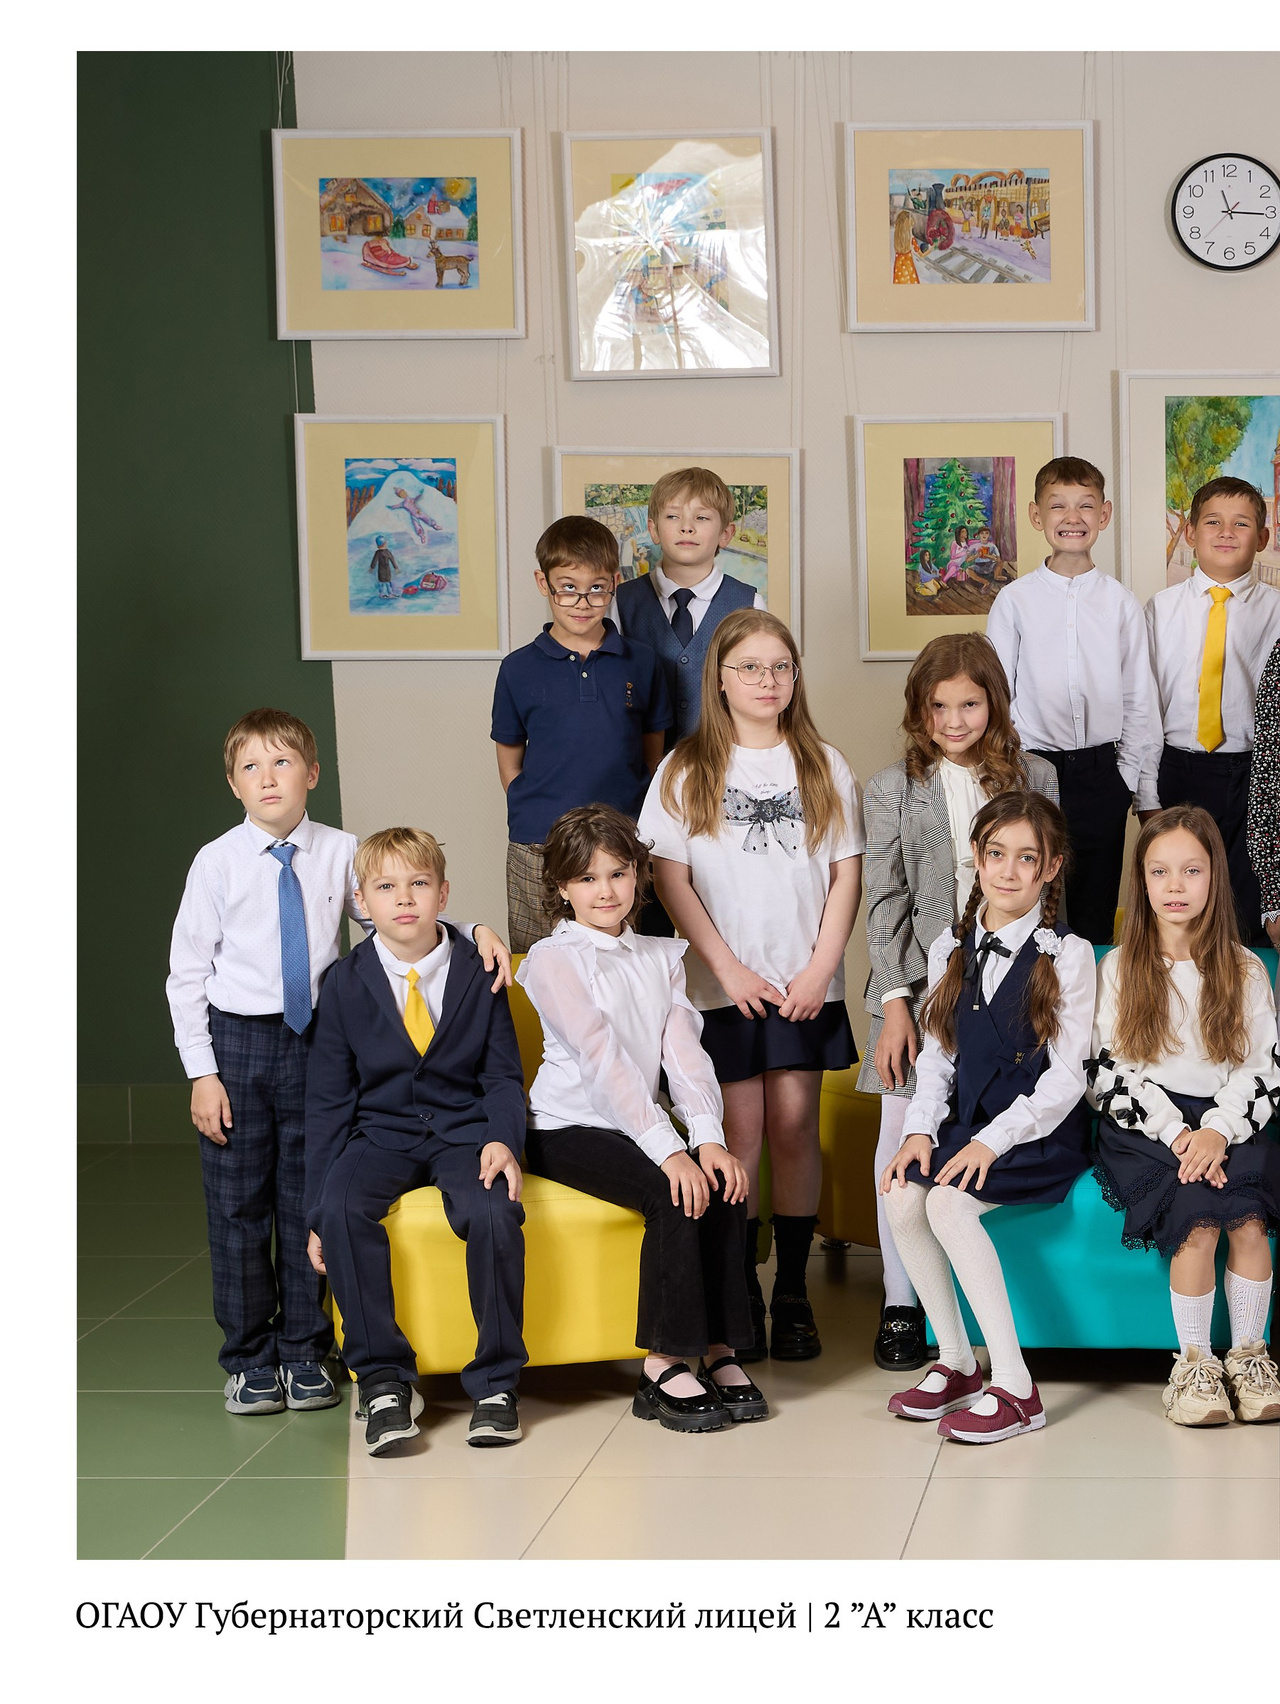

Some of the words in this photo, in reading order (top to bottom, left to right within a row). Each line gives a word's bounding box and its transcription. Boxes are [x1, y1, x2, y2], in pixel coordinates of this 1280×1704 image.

[1203, 169, 1214, 183] 11
[1221, 164, 1238, 178] 12
[1247, 169, 1252, 183] 1
[1187, 184, 1204, 198] 10
[1259, 184, 1271, 199] 2
[1182, 205, 1195, 219] 9
[1264, 205, 1277, 219] 3
[1189, 226, 1201, 240] 8
[1259, 226, 1271, 240] 4
[1204, 241, 1215, 255] 7
[1223, 246, 1236, 260] 6
[1243, 241, 1256, 256] 5
